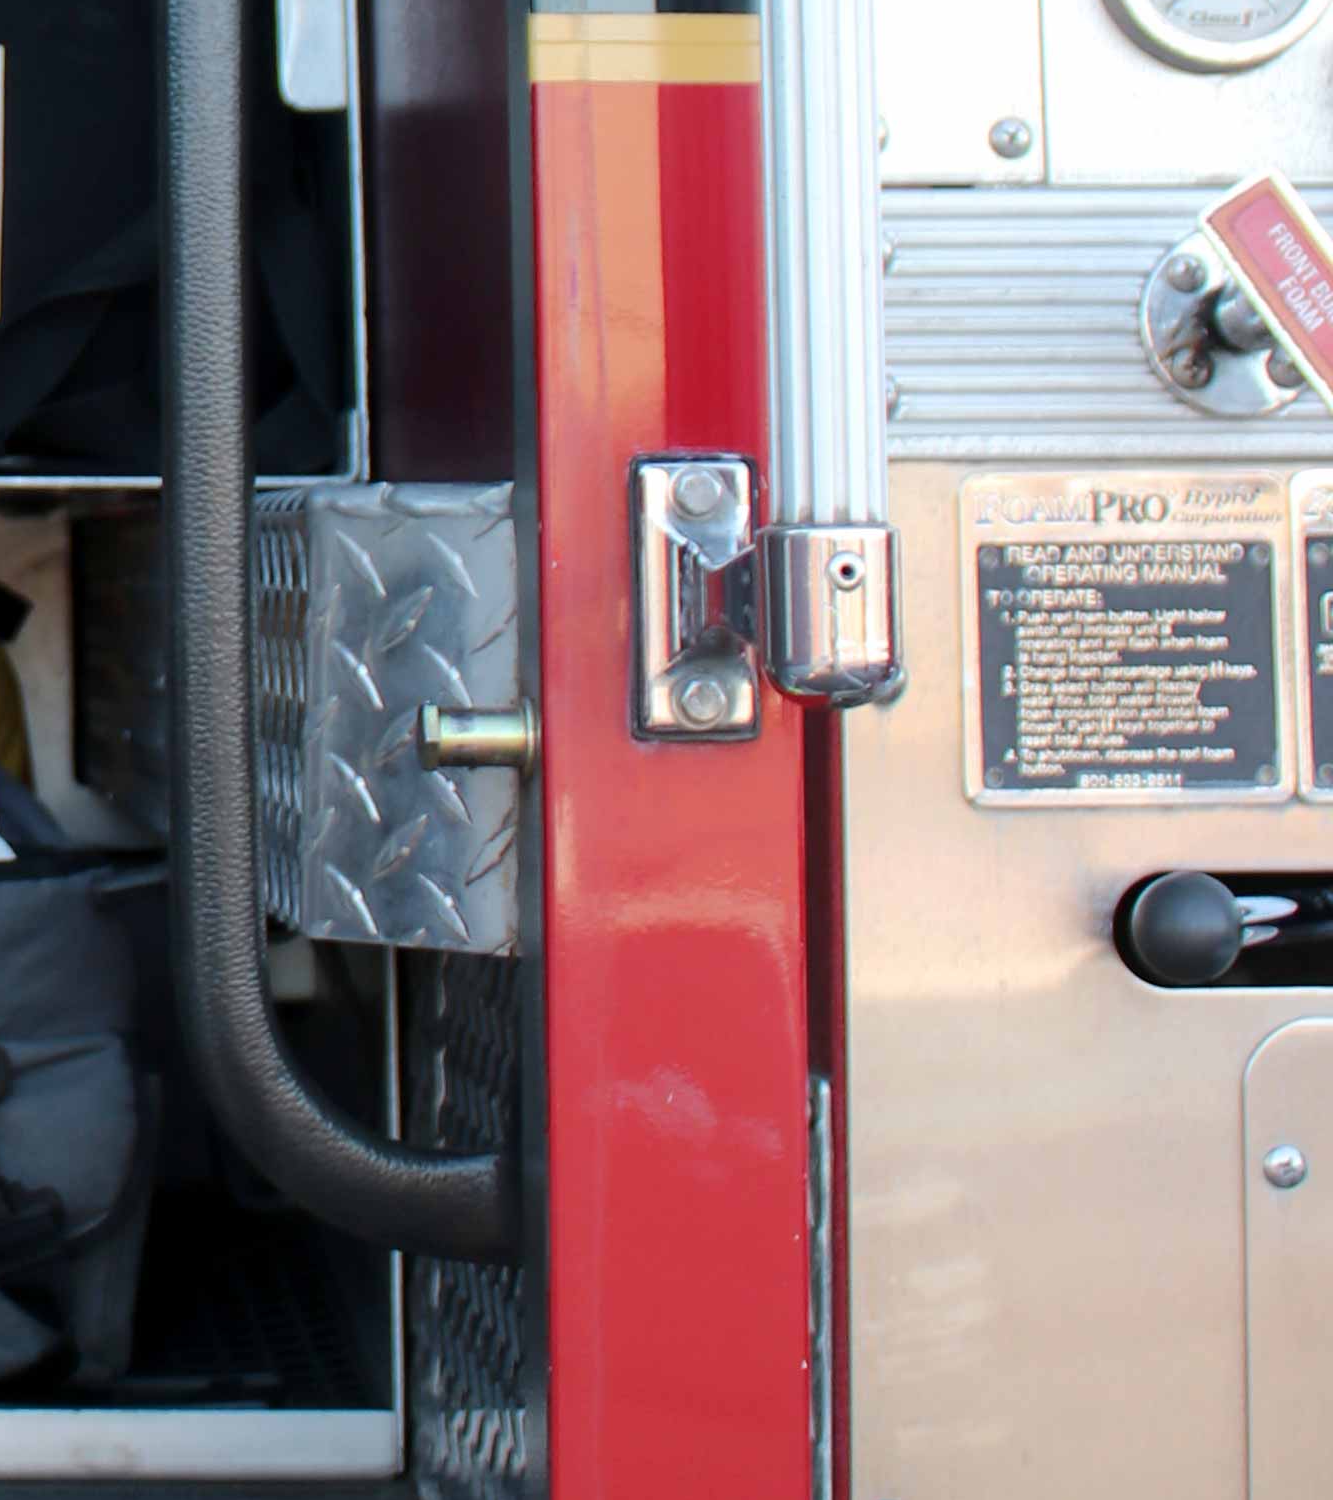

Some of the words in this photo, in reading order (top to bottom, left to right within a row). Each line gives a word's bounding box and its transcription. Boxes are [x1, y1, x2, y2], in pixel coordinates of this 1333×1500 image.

[1268, 221, 1318, 284] FRONT
[1276, 275, 1324, 334] FOAM
[1006, 544, 1060, 564] READ
[1064, 544, 1108, 563] AND
[1112, 543, 1245, 563] UNDERSTAND
[1025, 563, 1138, 583] OPERATING
[1143, 563, 1228, 583] MANUAL
[986, 589, 1014, 606] TO
[1017, 589, 1104, 608] OPERATE:
